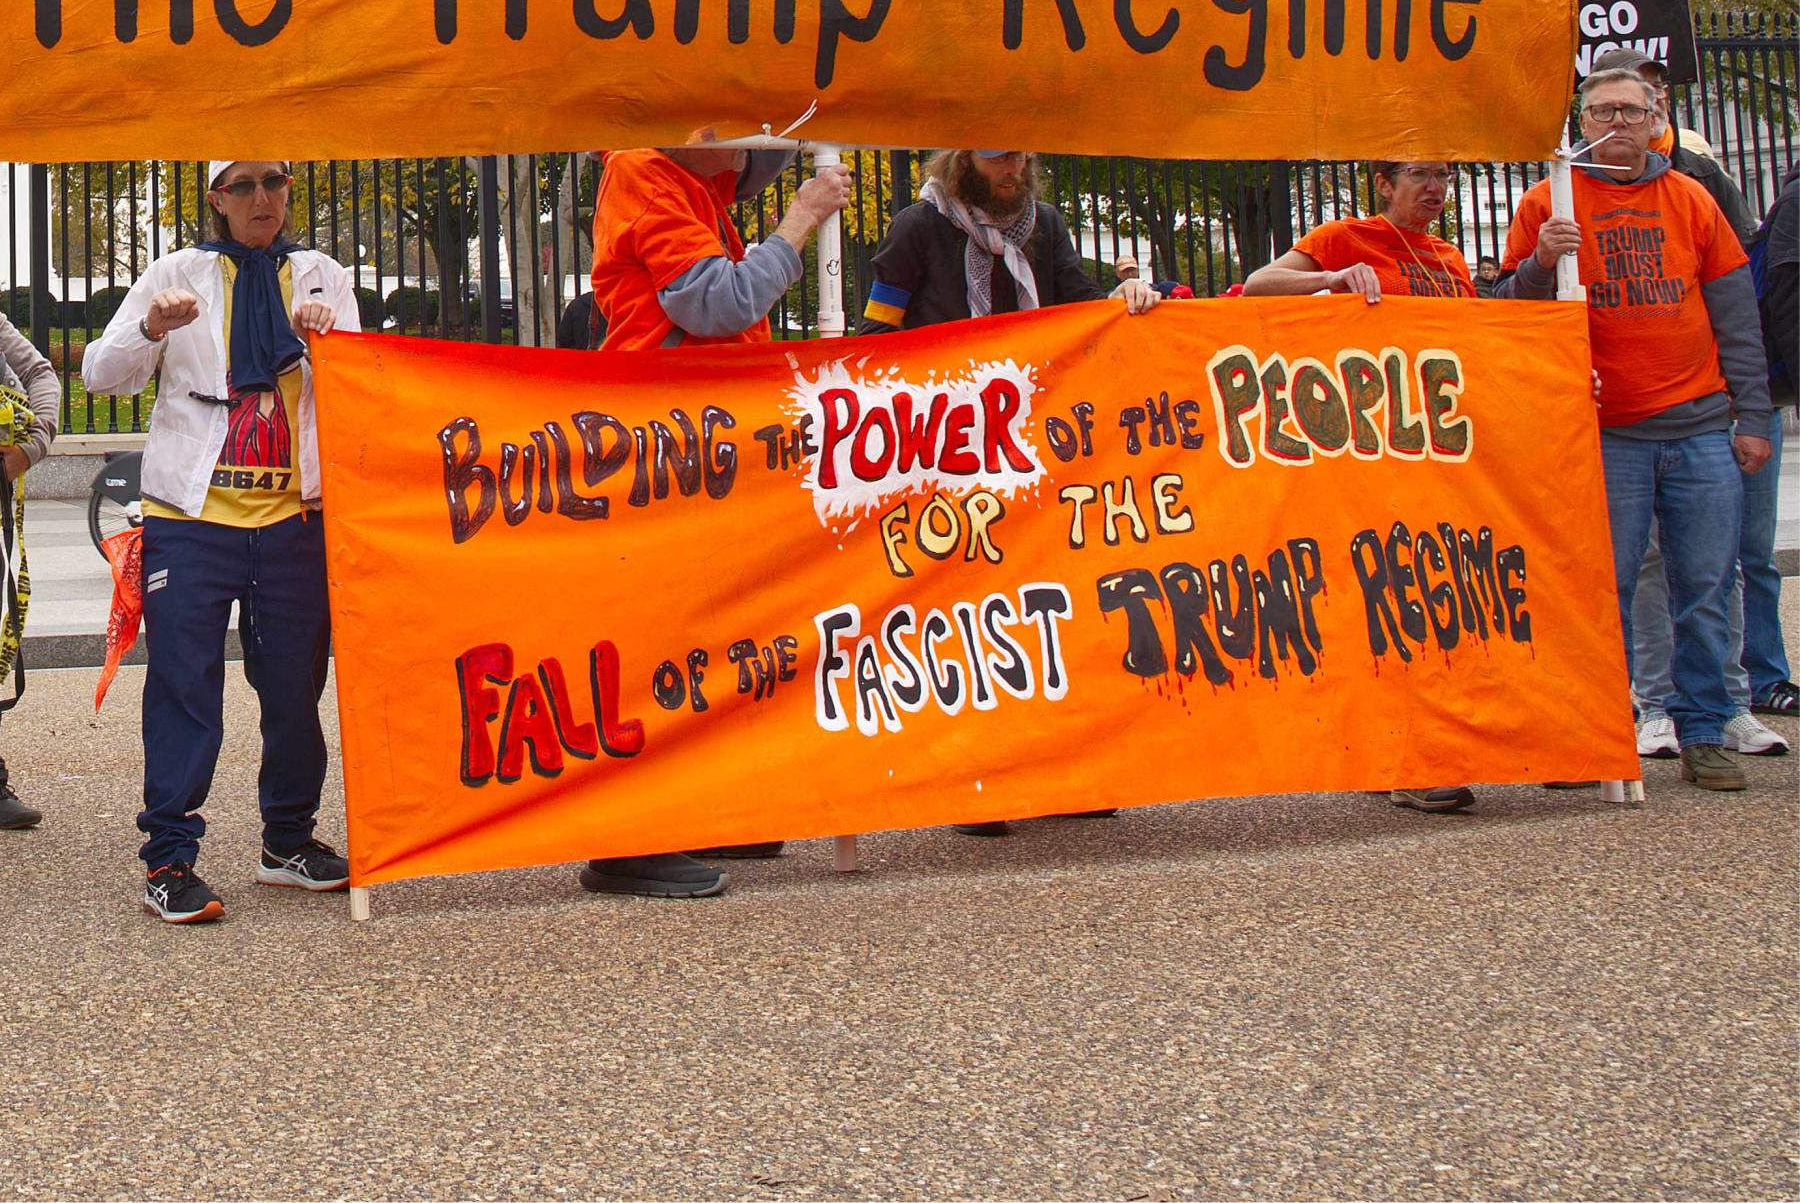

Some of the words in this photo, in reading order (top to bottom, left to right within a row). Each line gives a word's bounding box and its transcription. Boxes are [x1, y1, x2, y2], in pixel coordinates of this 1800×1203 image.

[1579, 1, 1638, 38] GO
[1594, 226, 1665, 255] TRUMP
[1605, 253, 1663, 280] MUST
[1590, 282, 1621, 309] GO
[1625, 277, 1685, 308] NOW!
[437, 404, 737, 544] BUILDING
[752, 414, 819, 472] THE
[816, 377, 1036, 490] POWER
[1044, 401, 1096, 463] OF
[1118, 390, 1205, 456] THE
[1207, 345, 1473, 469] PEOPLE
[209, 469, 293, 491] 8647
[879, 490, 1006, 579] FOR
[1058, 472, 1195, 551] THE
[457, 639, 645, 787] FALL
[652, 647, 709, 713] OF
[727, 634, 799, 702] THE
[814, 582, 1072, 738] FASCIST
[1097, 536, 1328, 687] TRUMP
[1350, 520, 1533, 665] REGIME
